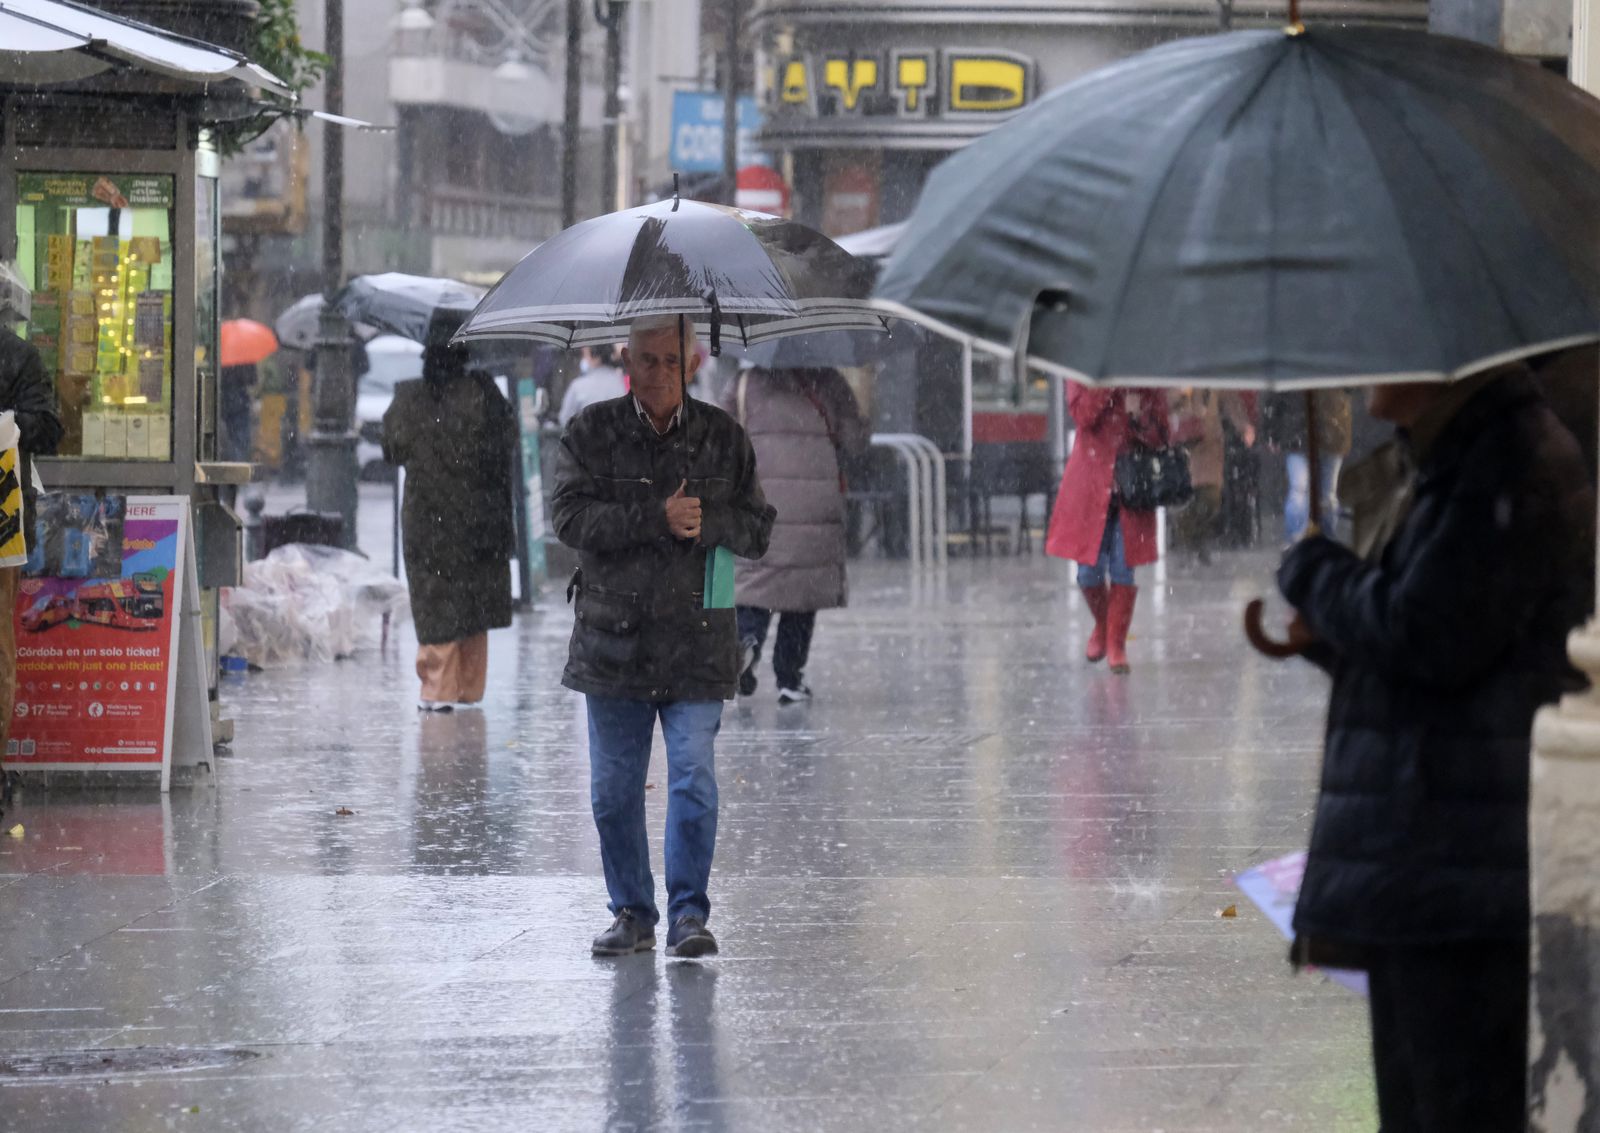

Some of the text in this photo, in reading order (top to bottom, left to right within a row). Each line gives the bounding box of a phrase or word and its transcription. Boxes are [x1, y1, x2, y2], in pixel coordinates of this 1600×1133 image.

[126, 506, 156, 516] HERE
[66, 649, 80, 657] en
[83, 648, 97, 657] un
[99, 647, 123, 657] solo
[126, 647, 160, 657] ticket!
[57, 661, 80, 671] with
[82, 662, 103, 673] just
[130, 661, 164, 672] ticket!
[31, 705, 45, 716] 17
